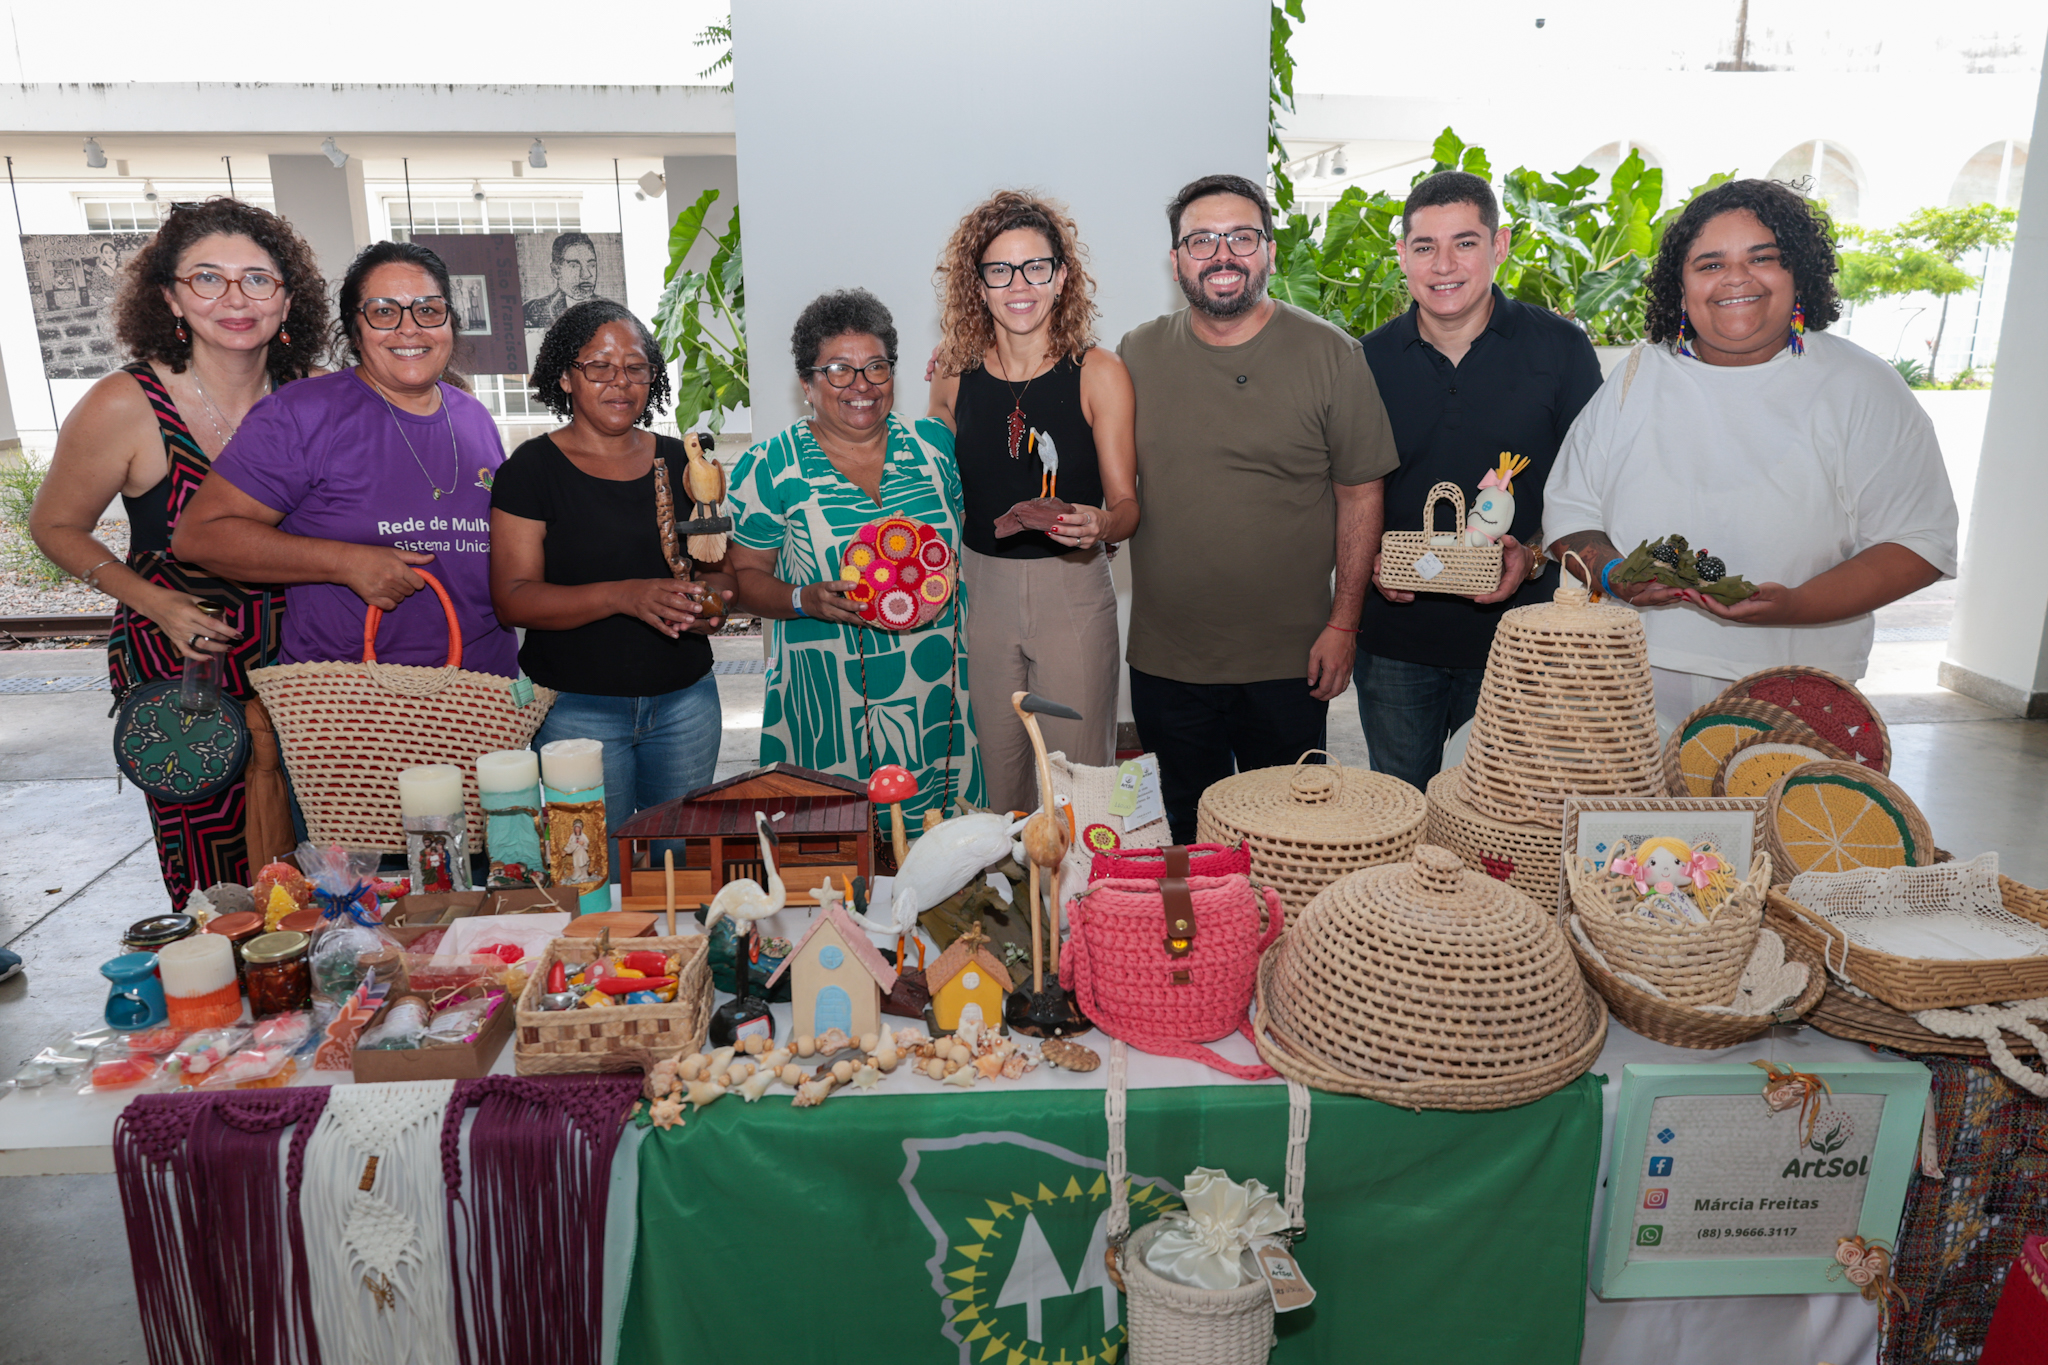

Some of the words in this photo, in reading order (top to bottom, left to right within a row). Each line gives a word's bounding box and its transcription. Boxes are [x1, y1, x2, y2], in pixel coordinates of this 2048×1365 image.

[500, 295, 522, 371] Francisco
[377, 517, 425, 535] Rede
[429, 516, 448, 531] de
[394, 540, 450, 552] Sistema
[1782, 1155, 1868, 1178] ArtSol
[1694, 1197, 1754, 1211] Márcia
[1759, 1197, 1819, 1210] Freitas
[1697, 1229, 1721, 1240] (88)
[1724, 1227, 1797, 1237] 9.9666.3117
